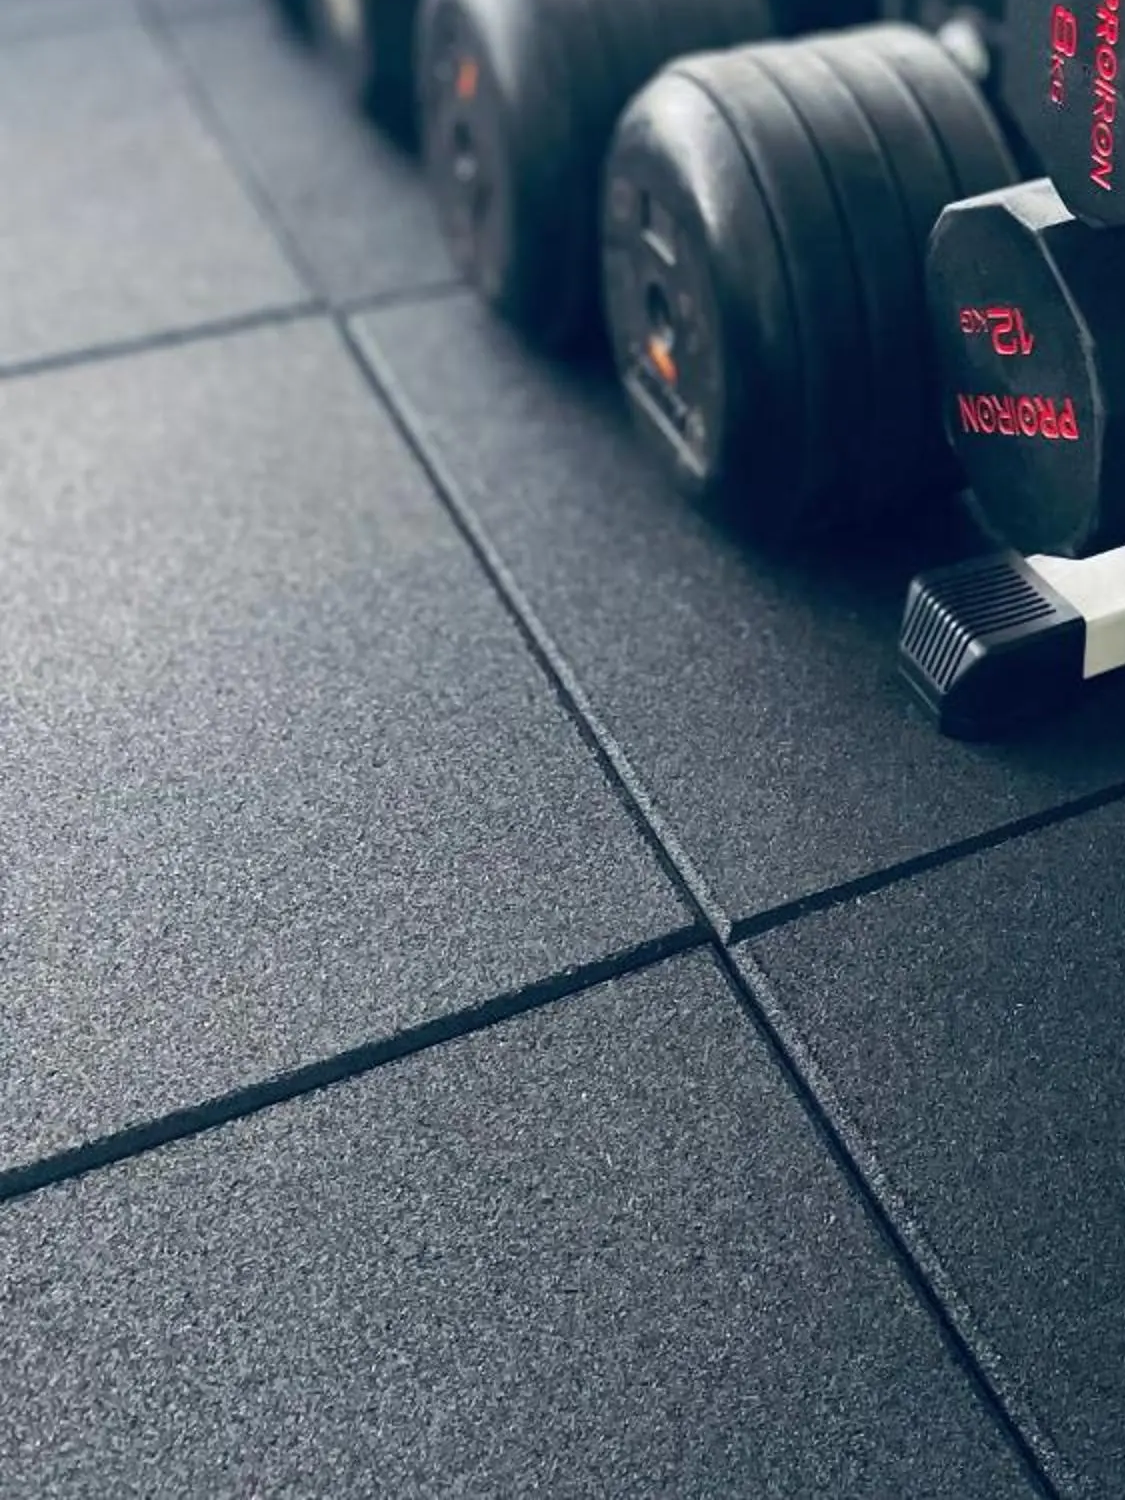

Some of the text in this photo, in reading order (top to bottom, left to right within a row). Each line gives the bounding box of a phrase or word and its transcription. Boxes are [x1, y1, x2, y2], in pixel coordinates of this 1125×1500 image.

[1050, 3, 1078, 105] 8KG
[960, 306, 1035, 355] 12KG
[958, 393, 1080, 440] PROIRON
